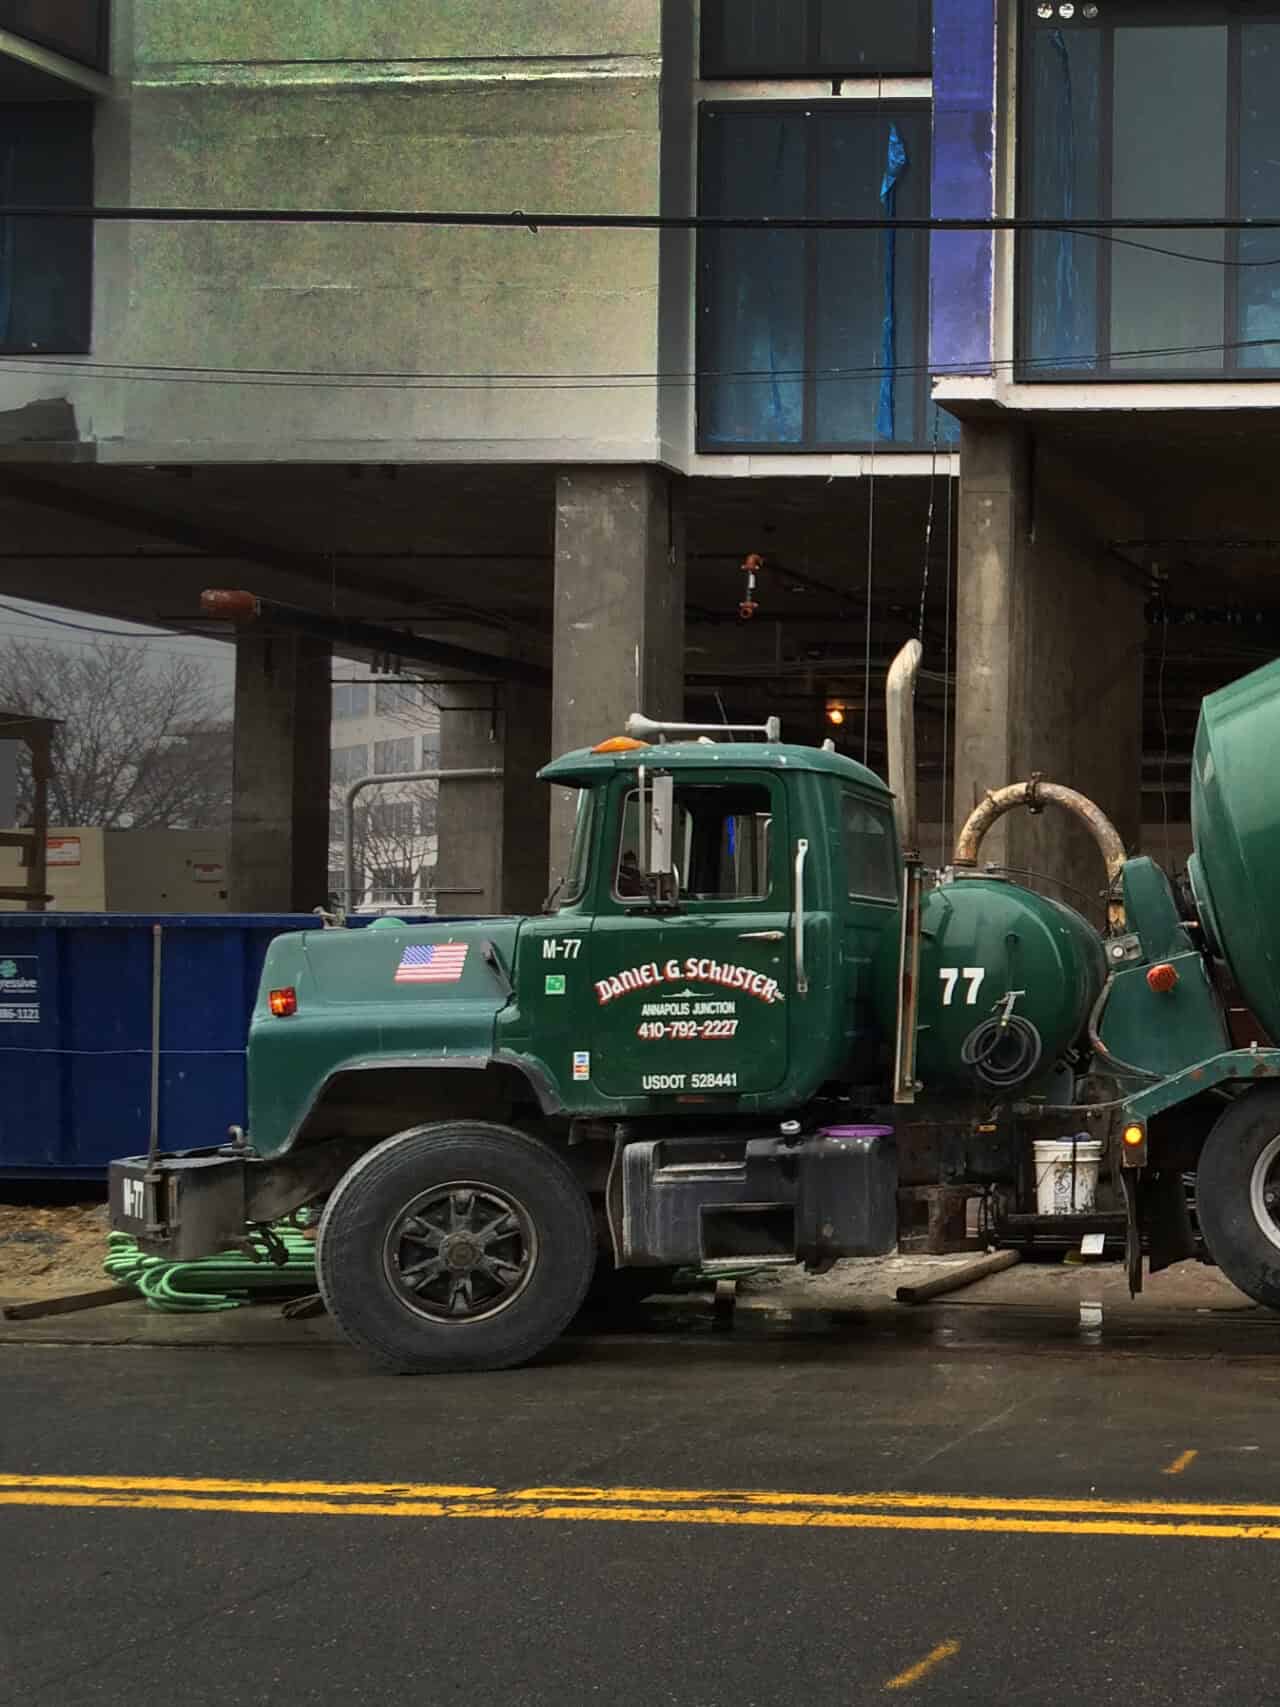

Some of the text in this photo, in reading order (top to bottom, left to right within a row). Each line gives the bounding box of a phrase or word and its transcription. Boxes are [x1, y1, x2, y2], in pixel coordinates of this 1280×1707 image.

[543, 939, 581, 959] M-77
[939, 967, 985, 1005] 77
[641, 1001, 736, 1016] ANNAPOLIS JUNCTION
[637, 1020, 739, 1039] 410-792-2227
[642, 1073, 737, 1090] USDOT 528441
